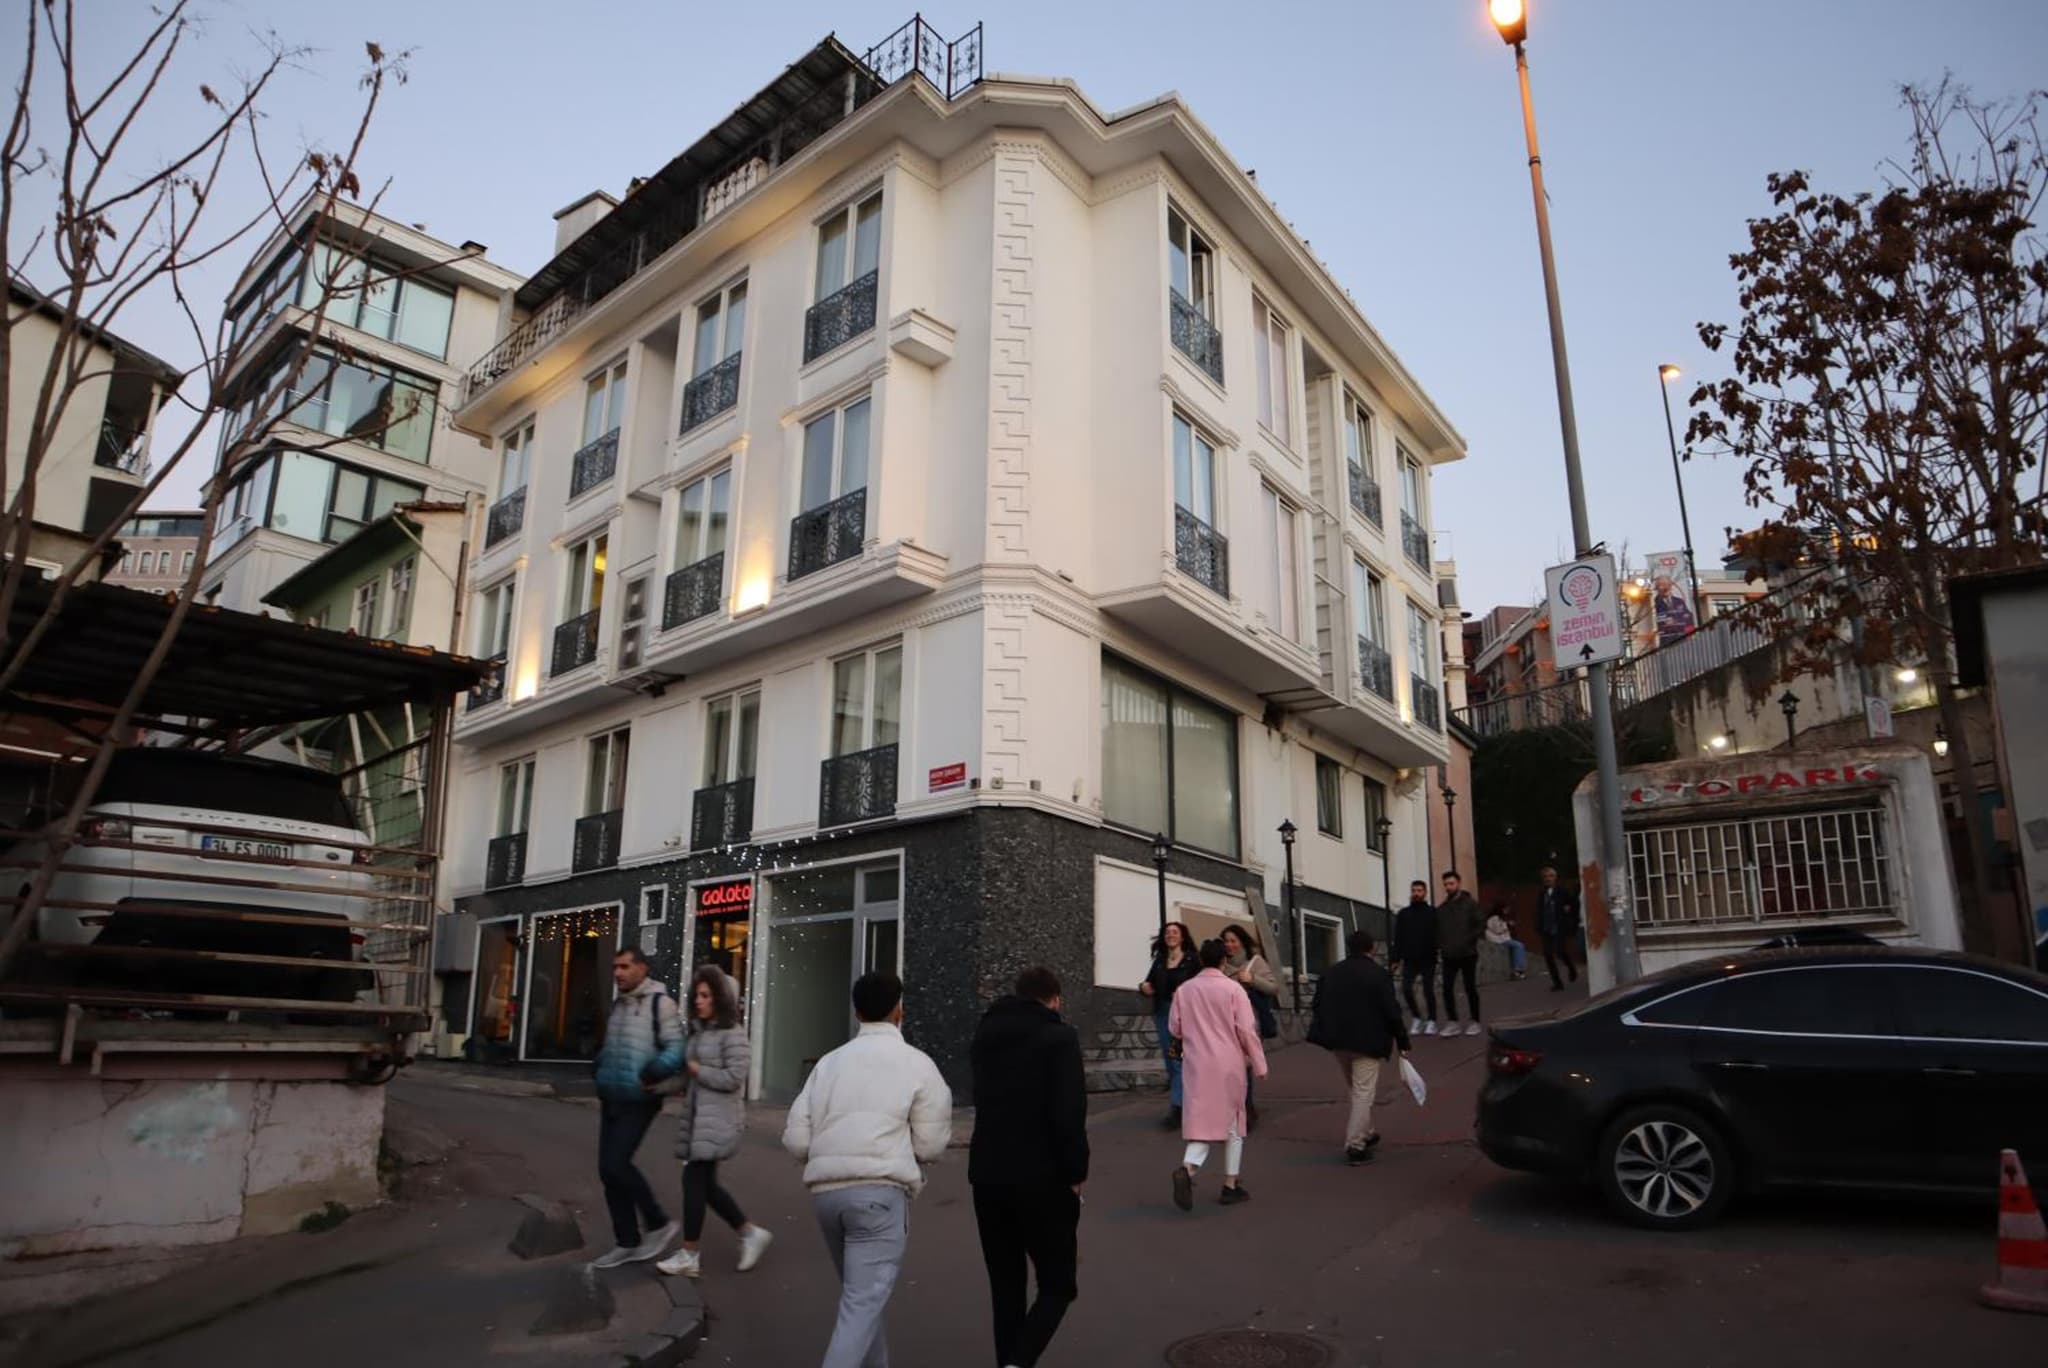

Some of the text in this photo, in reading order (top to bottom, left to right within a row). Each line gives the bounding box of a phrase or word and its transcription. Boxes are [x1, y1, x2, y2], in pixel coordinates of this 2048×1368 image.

[1562, 611, 1605, 632] zemin
[1556, 621, 1614, 647] istanbul
[1630, 764, 1882, 803] OTOPARK
[213, 840, 228, 854] 34
